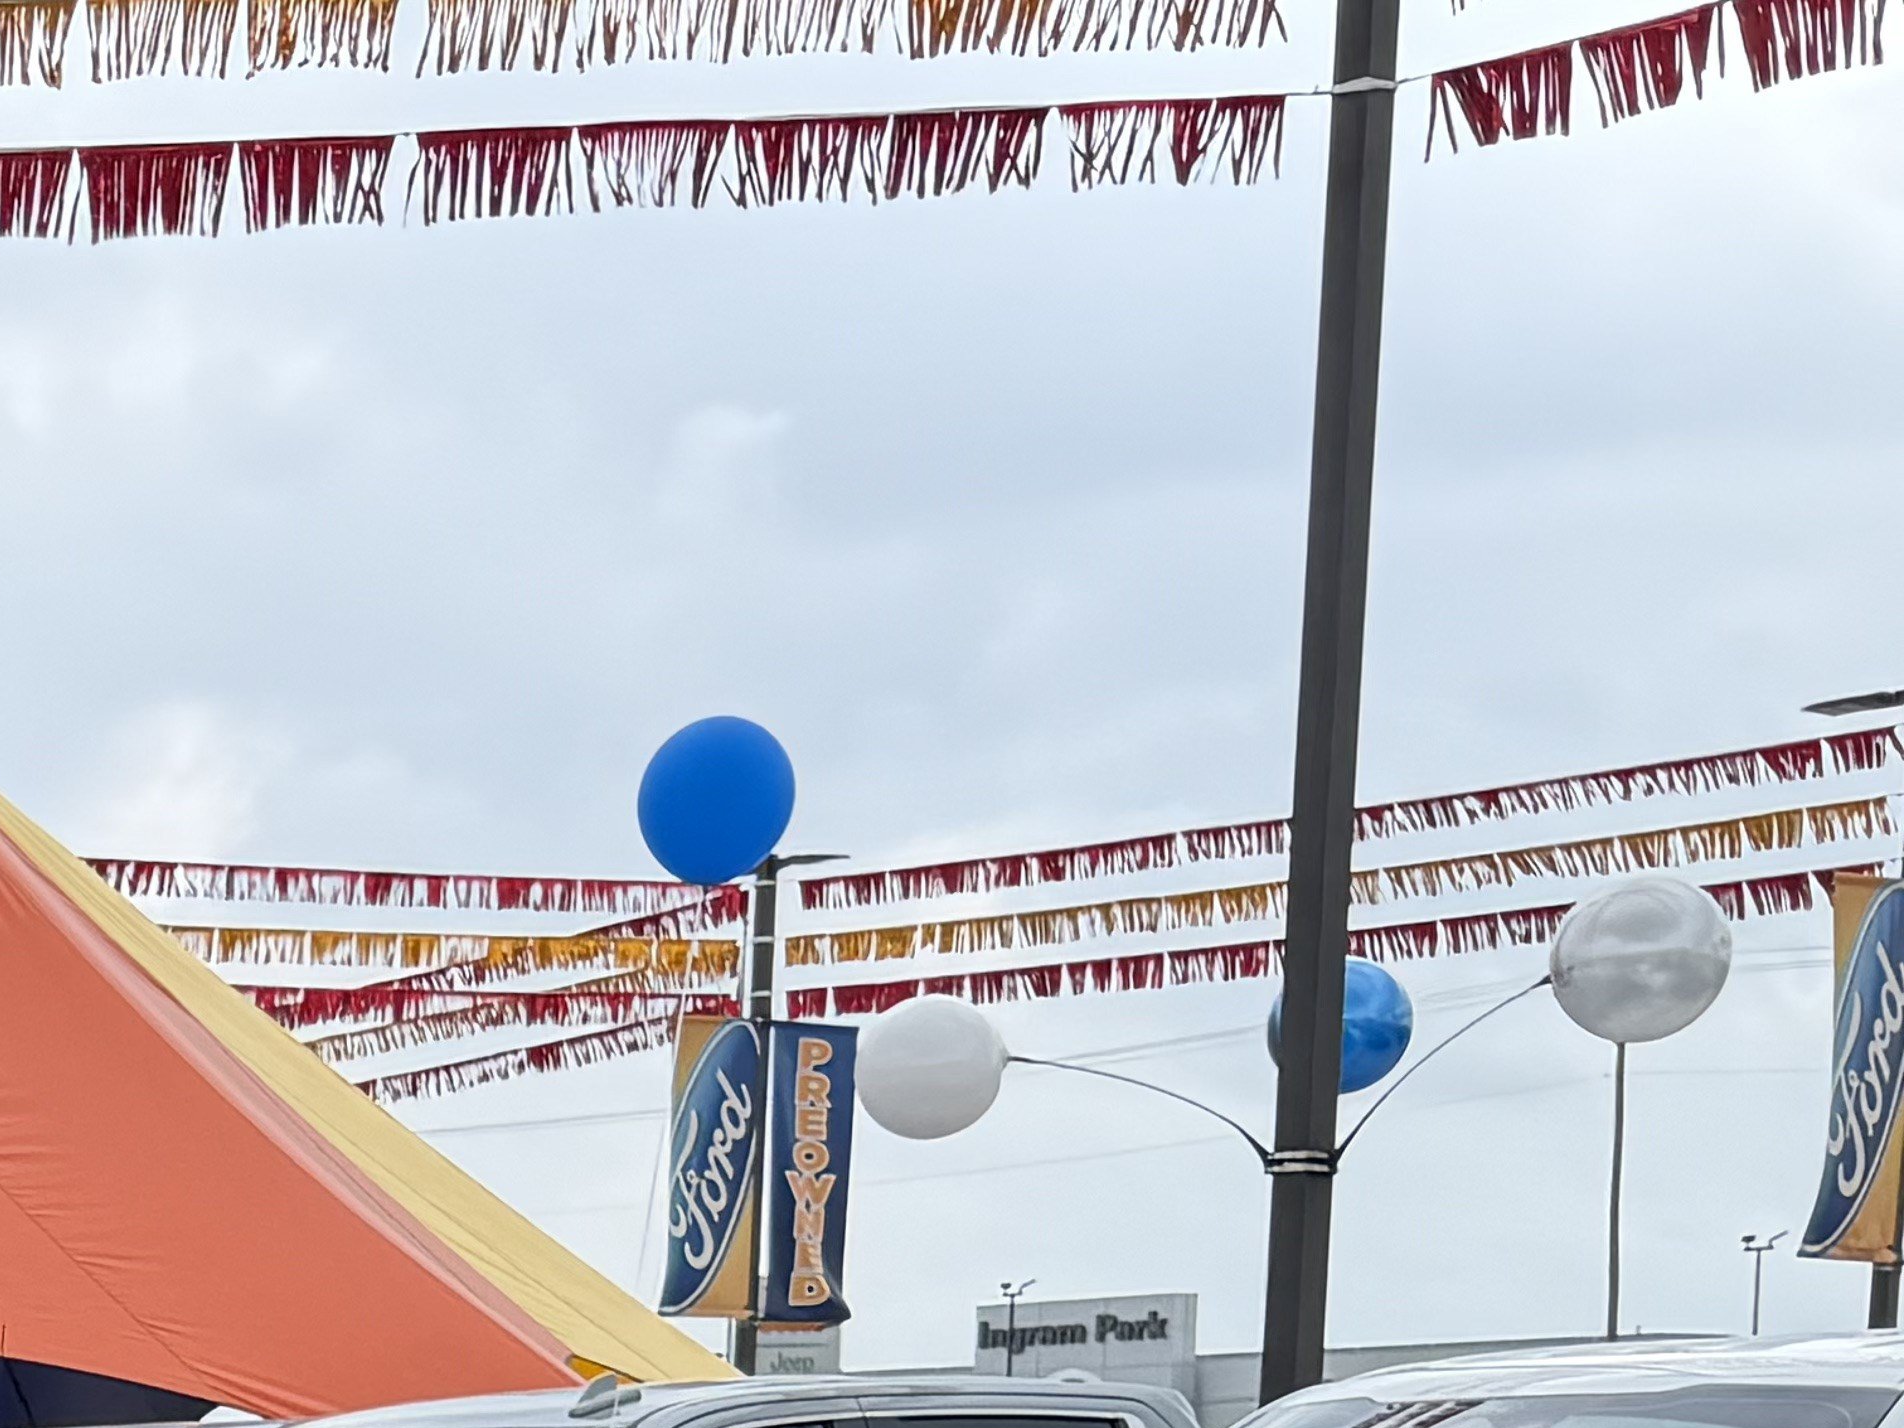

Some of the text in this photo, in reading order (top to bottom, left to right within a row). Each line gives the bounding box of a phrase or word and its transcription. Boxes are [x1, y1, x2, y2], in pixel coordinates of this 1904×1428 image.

[668, 1066, 752, 1270] Ford
[978, 1310, 1169, 1355] Ingram Park
